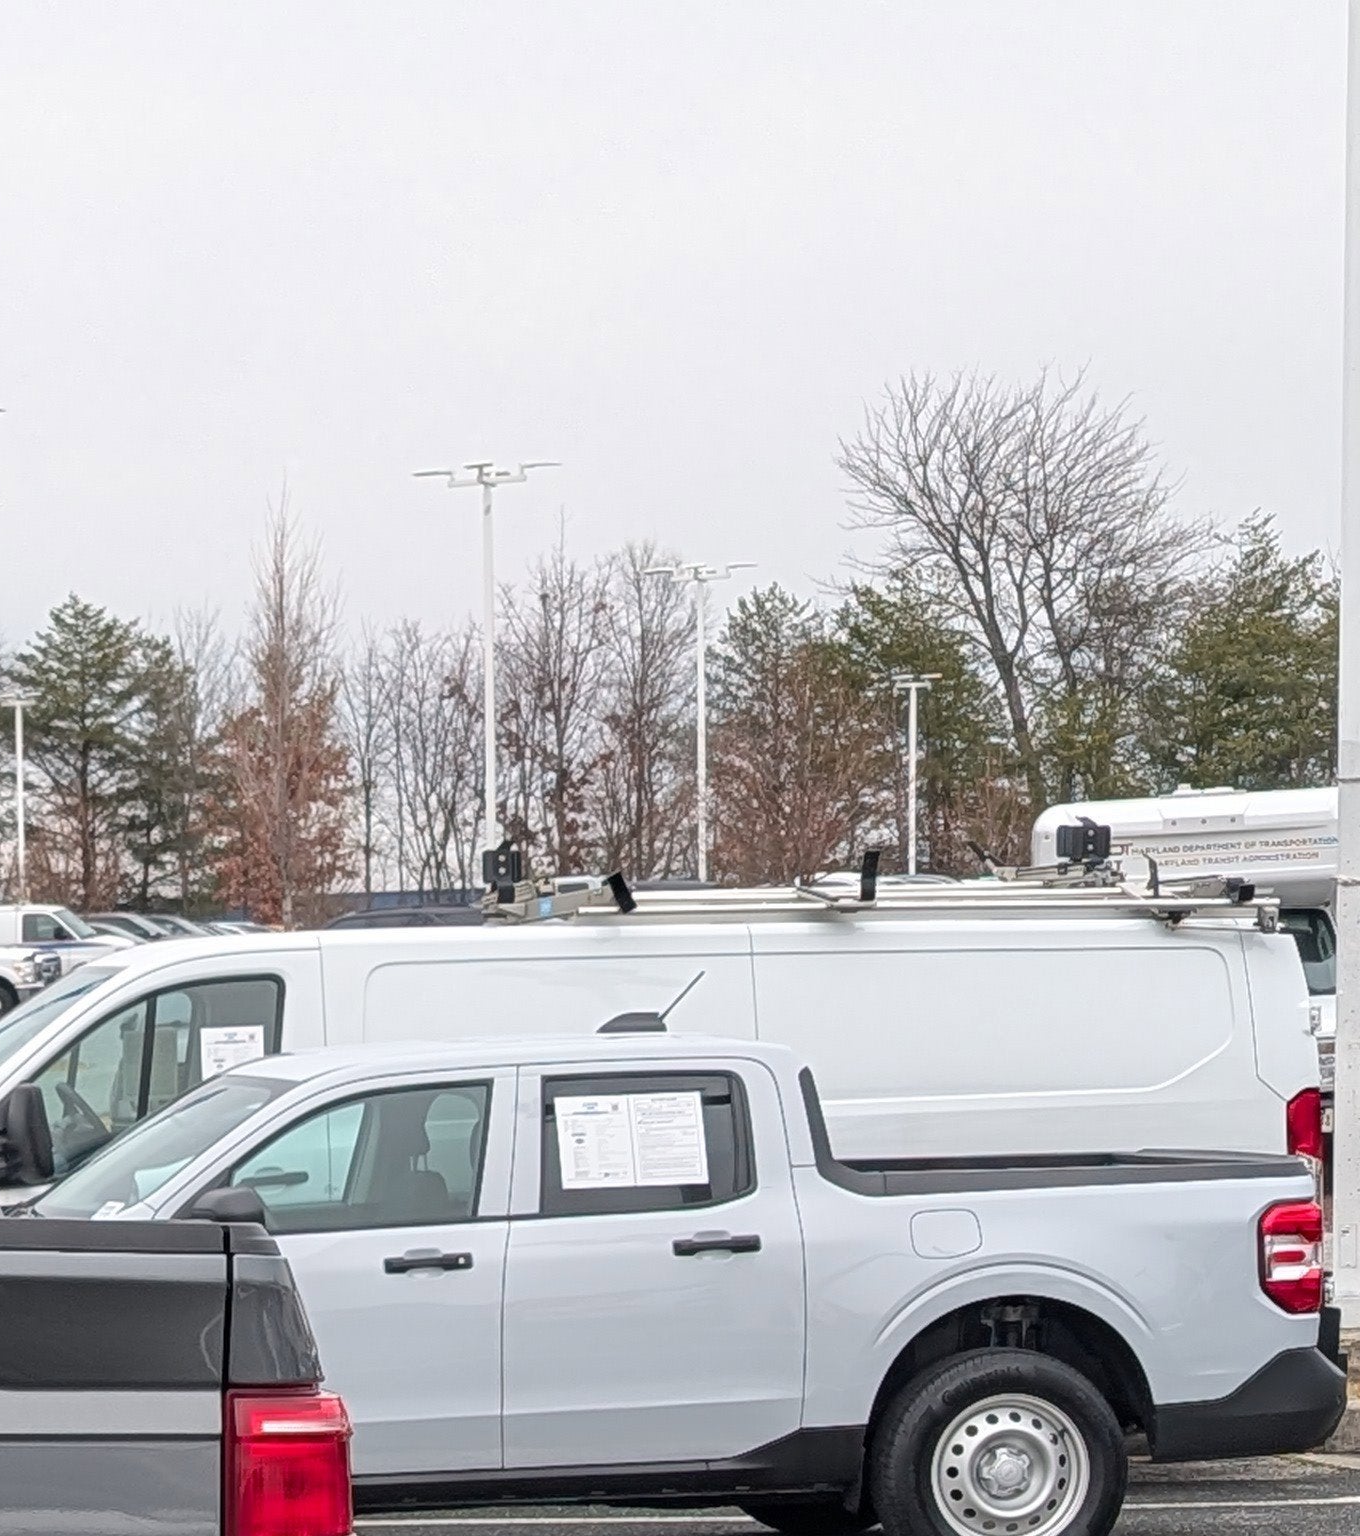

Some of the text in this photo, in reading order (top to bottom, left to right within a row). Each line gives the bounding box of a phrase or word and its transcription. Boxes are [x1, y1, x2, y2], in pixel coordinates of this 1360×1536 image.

[1131, 846, 1181, 855] MARYLAND
[1182, 842, 1242, 853] DEPARTMENT
[1244, 841, 1257, 849] OF
[1157, 857, 1200, 867] ARYLAND
